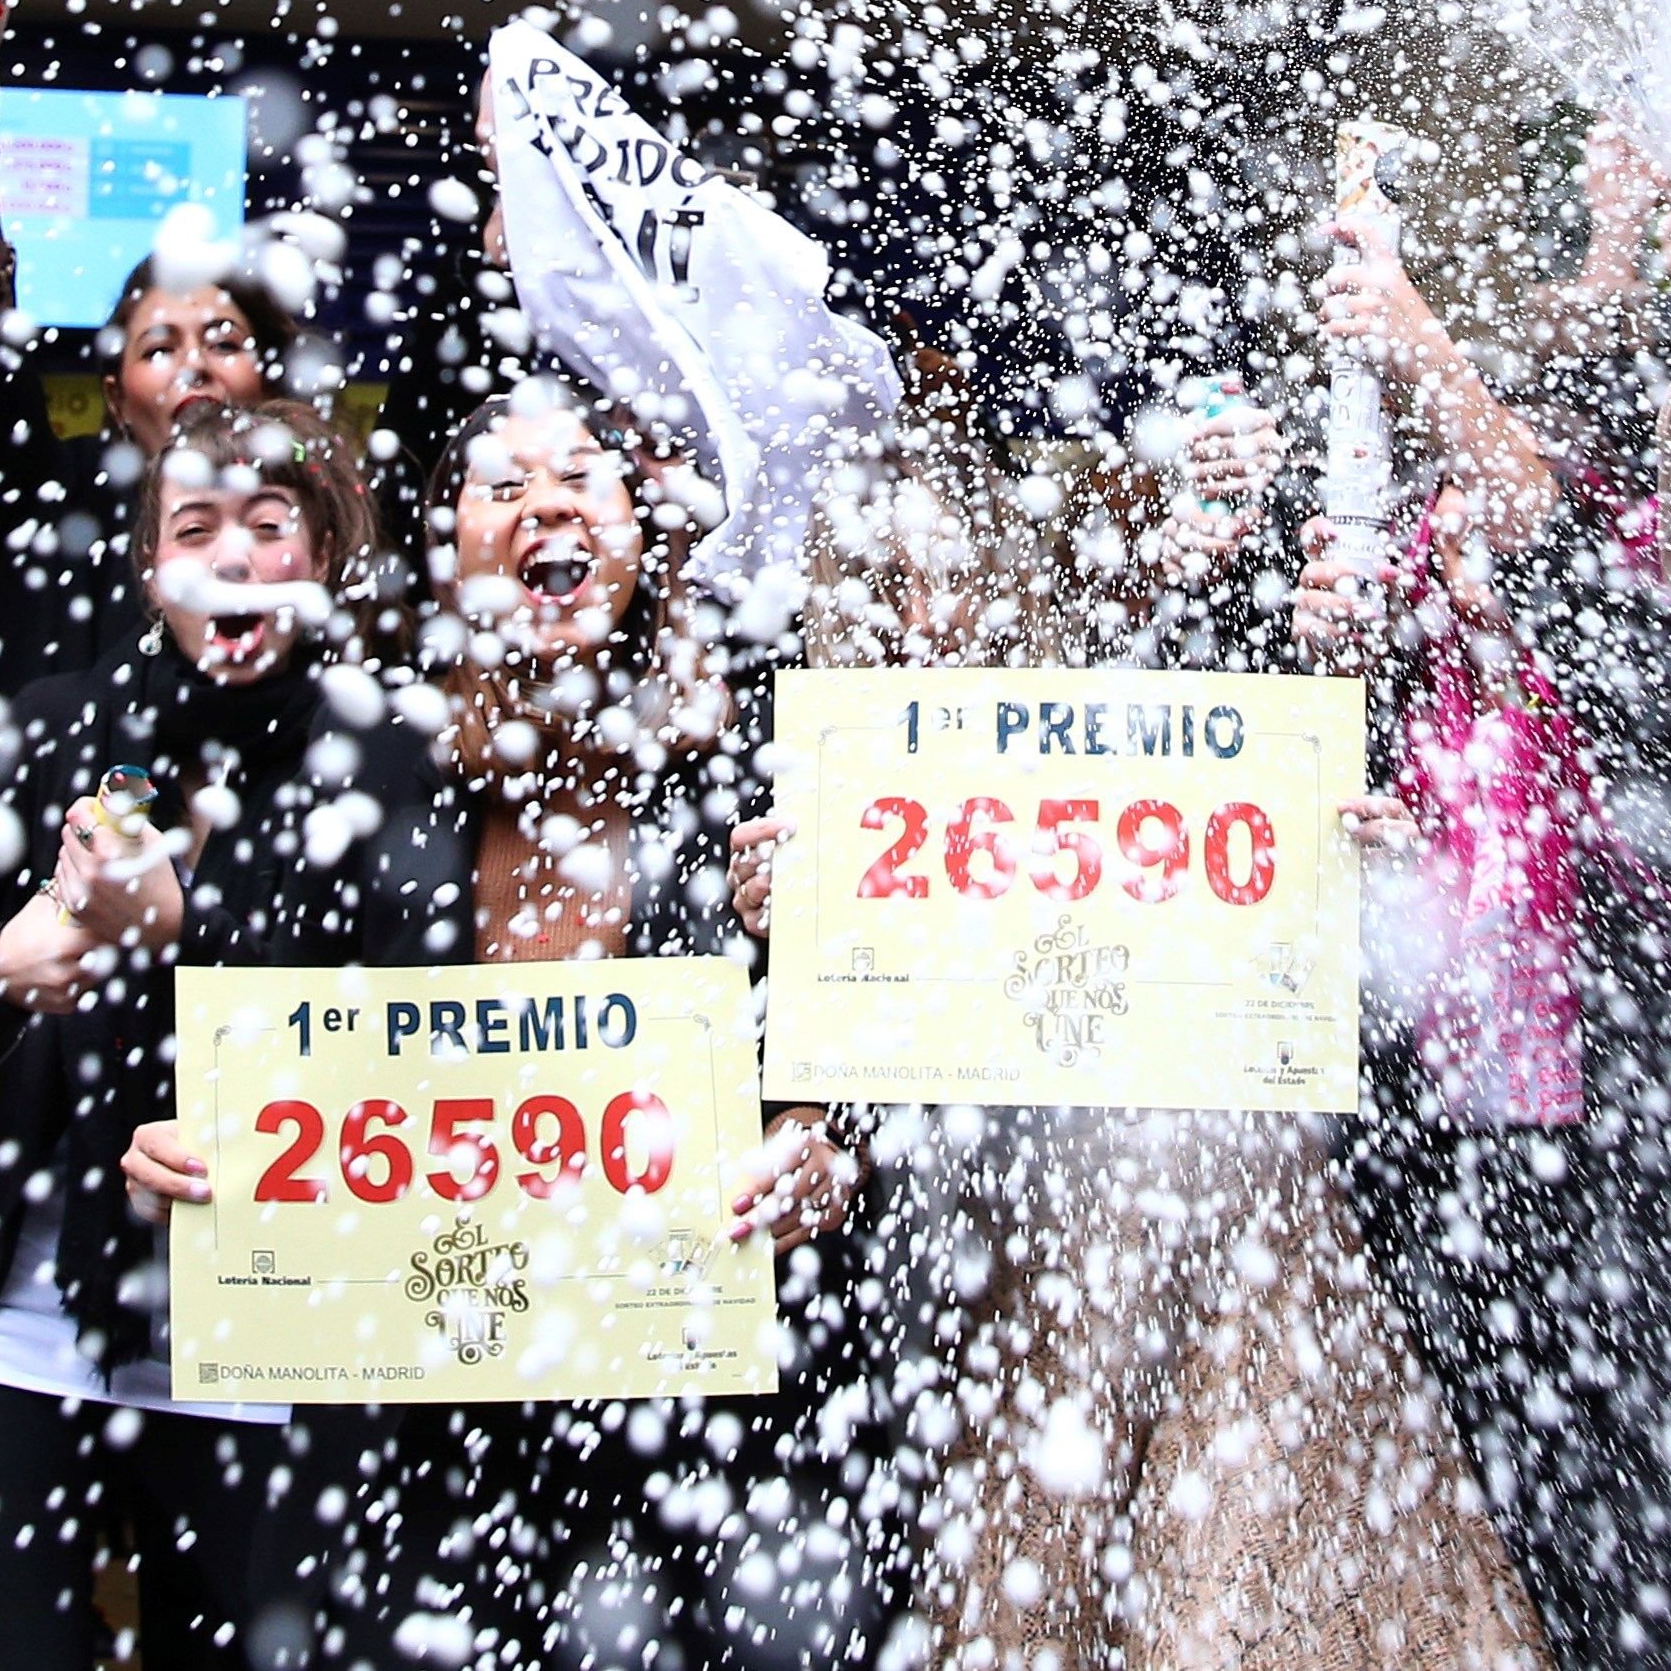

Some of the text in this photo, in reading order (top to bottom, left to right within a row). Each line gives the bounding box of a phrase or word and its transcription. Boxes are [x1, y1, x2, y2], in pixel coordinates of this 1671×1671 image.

[996, 700, 1247, 761] PREMIO
[856, 795, 1278, 907] 26590
[287, 992, 639, 1057] 1er PREMIO
[862, 1065, 945, 1081] MANOLITA
[252, 1089, 678, 1205] 26590
[219, 1364, 265, 1380] DOÑA
[268, 1366, 349, 1381] MANOLITA
[361, 1366, 426, 1381] MADRID
